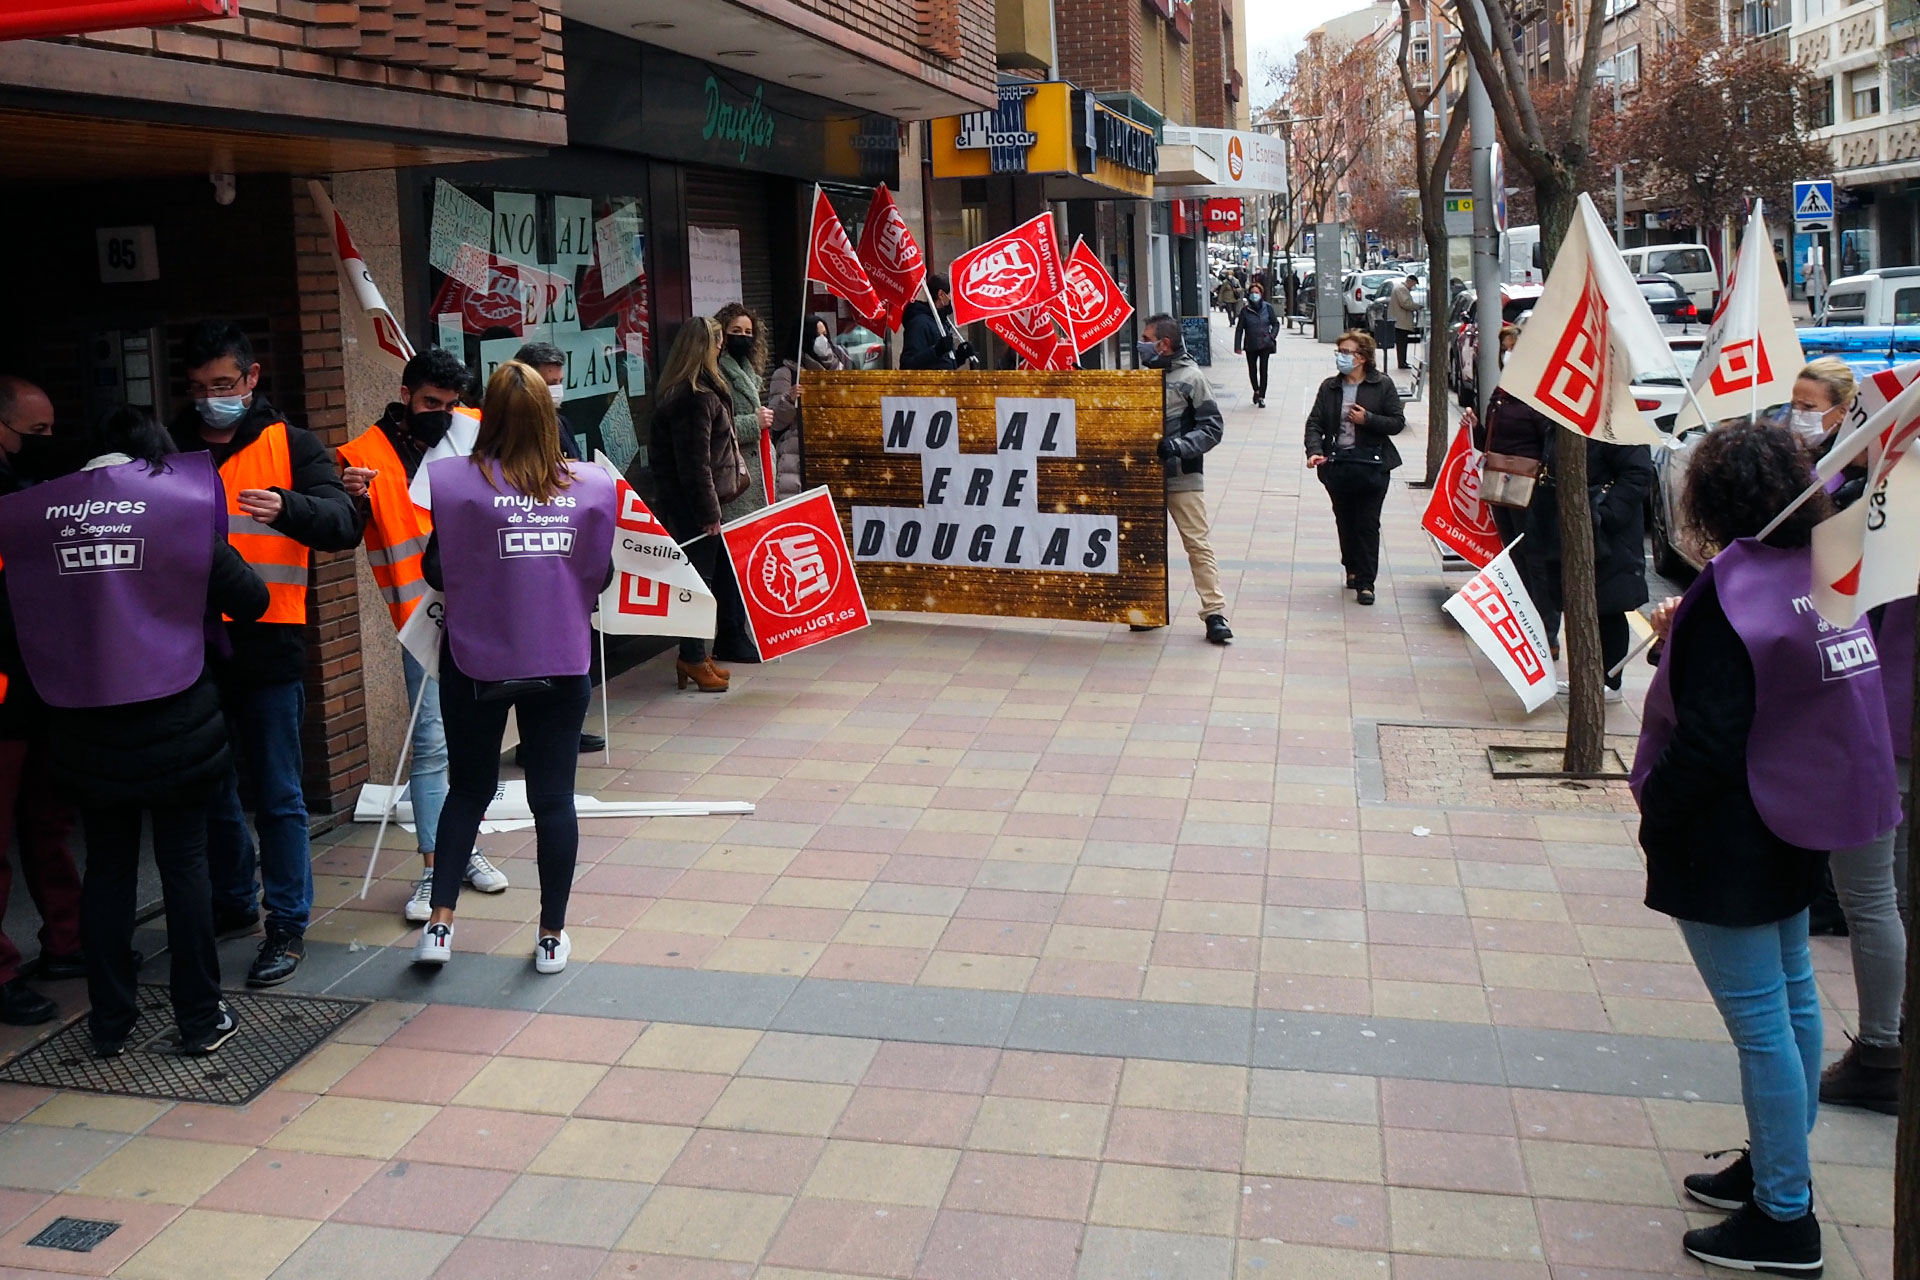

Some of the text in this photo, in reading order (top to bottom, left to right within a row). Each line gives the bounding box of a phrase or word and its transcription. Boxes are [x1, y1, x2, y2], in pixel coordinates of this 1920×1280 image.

[703, 76, 775, 163] Douglas
[957, 126, 1035, 147] el hogar
[497, 212, 536, 255] NO
[557, 216, 590, 255] AL
[108, 239, 136, 270] 85
[969, 242, 1022, 282] UGT
[1036, 221, 1057, 292] www.UGT.es
[524, 283, 576, 326] ERE
[1065, 264, 1104, 317] UGT
[995, 322, 1038, 360] www.ugt.es
[1080, 306, 1122, 341] www.ugt.es
[887, 410, 1061, 451] NO AL
[927, 467, 1029, 507] ERE
[46, 499, 147, 522] mujeres
[60, 523, 132, 538] de Segovia
[508, 512, 569, 526] de Segovia
[61, 544, 136, 568] CCOO
[505, 532, 572, 552] CCOO
[622, 538, 681, 561] Castilla
[857, 519, 1112, 569] DOUGLAS
[1434, 516, 1495, 560] www.ugt.es
[780, 533, 830, 600] UGT
[766, 608, 856, 645] www.UGT.es
[1464, 577, 1539, 678] CCOO
[1492, 565, 1547, 658] Castilla y León
